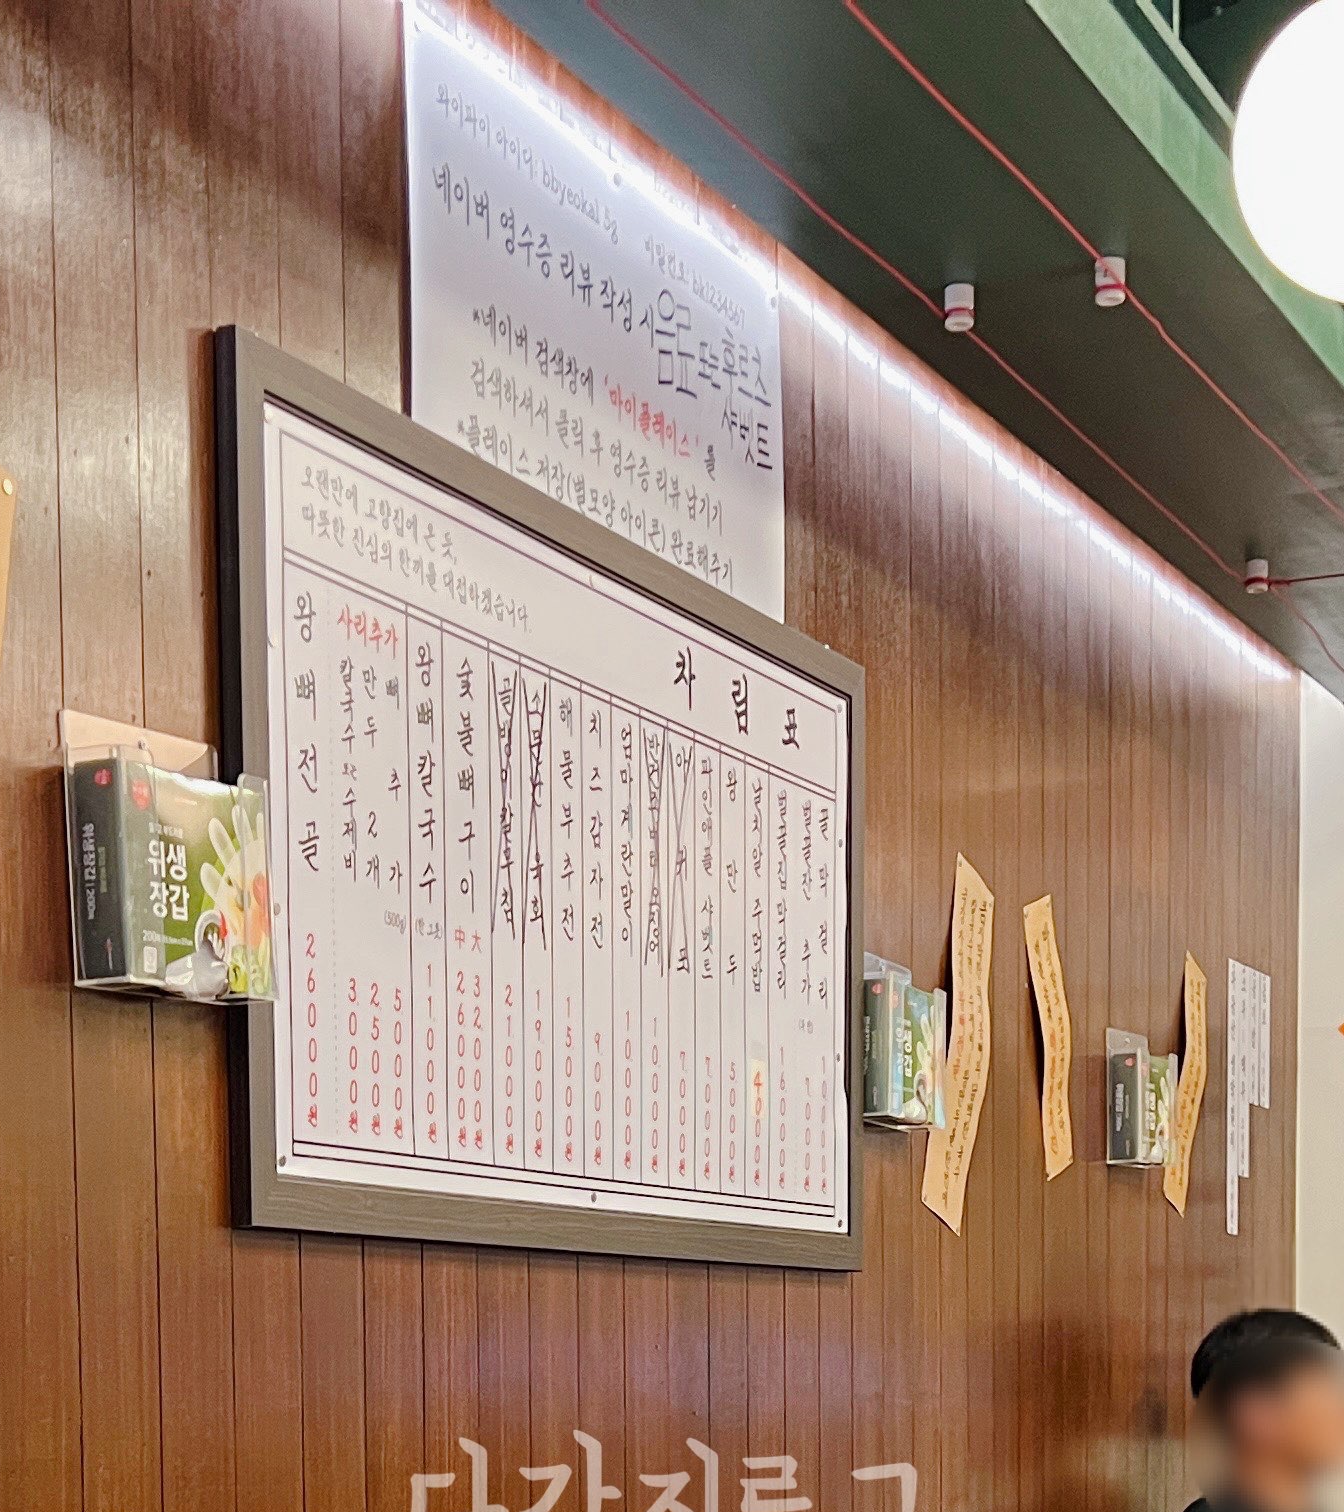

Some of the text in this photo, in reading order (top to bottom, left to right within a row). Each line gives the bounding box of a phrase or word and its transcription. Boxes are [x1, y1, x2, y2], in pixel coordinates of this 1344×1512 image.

[436, 83, 490, 148] 와이파이
[432, 162, 490, 240] 네이버
[500, 207, 553, 279] 영수증
[560, 250, 594, 303] 리뷰
[600, 276, 633, 333] 작성
[639, 304, 654, 349] 시
[655, 289, 697, 399] 음료
[535, 337, 594, 408] 검색창에
[471, 357, 723, 536] 검색하셔서 클릭 후 영수증 리뷰 남기기
[301, 503, 346, 548] 따뜻한
[352, 526, 393, 572] 진심의
[399, 548, 438, 593] 한끼를
[365, 498, 419, 545] 고향집에
[424, 522, 436, 552] 온
[336, 604, 399, 660] 사리추가
[293, 590, 320, 872] 왕뼈전골
[362, 665, 378, 748] 만두
[673, 646, 801, 750] 차림표
[415, 642, 437, 904] 왕뼈칼국수
[455, 657, 476, 914] 숯불뼈구이
[559, 697, 574, 942] 해물부추전
[147, 839, 189, 882] 위생
[588, 710, 603, 950] 치즈감자전
[149, 881, 190, 922] 장갑
